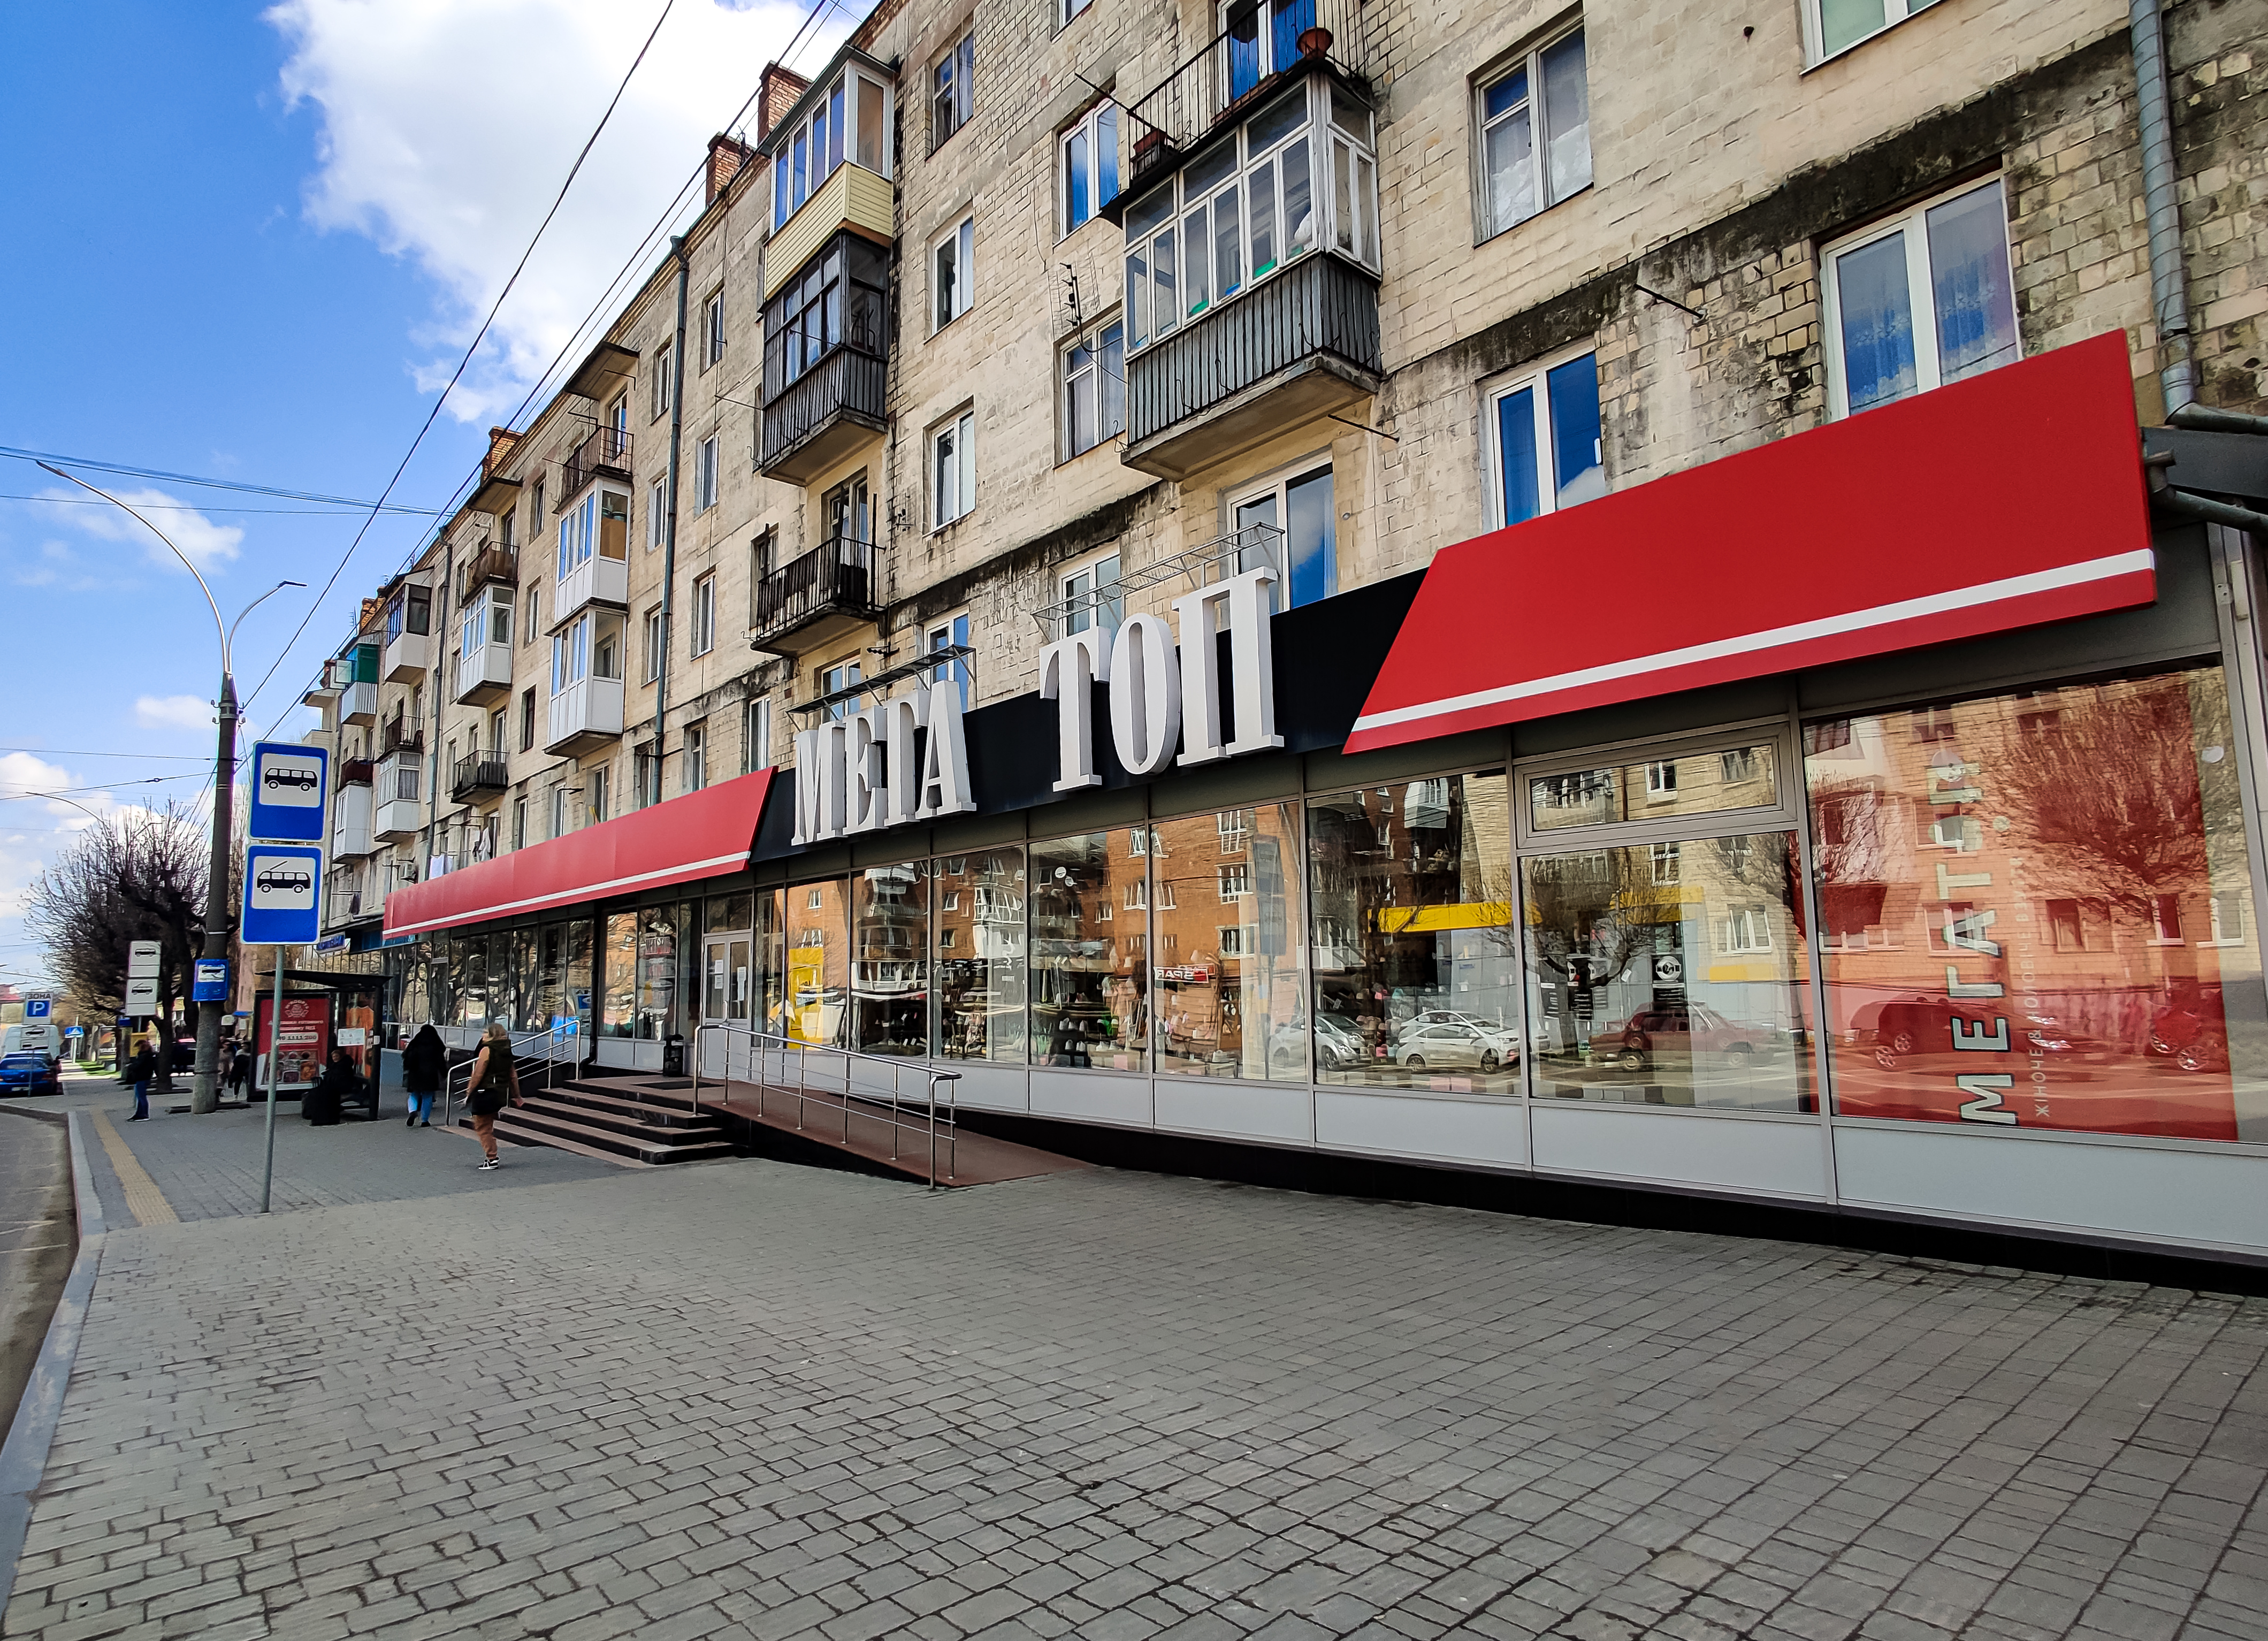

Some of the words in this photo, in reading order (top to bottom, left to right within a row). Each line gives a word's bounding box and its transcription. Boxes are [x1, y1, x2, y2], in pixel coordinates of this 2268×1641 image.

[791, 680, 977, 846] МЕГА
[1038, 566, 1284, 792] ТОП
[2029, 1048, 2050, 1117] ЖІНОЧЕ
